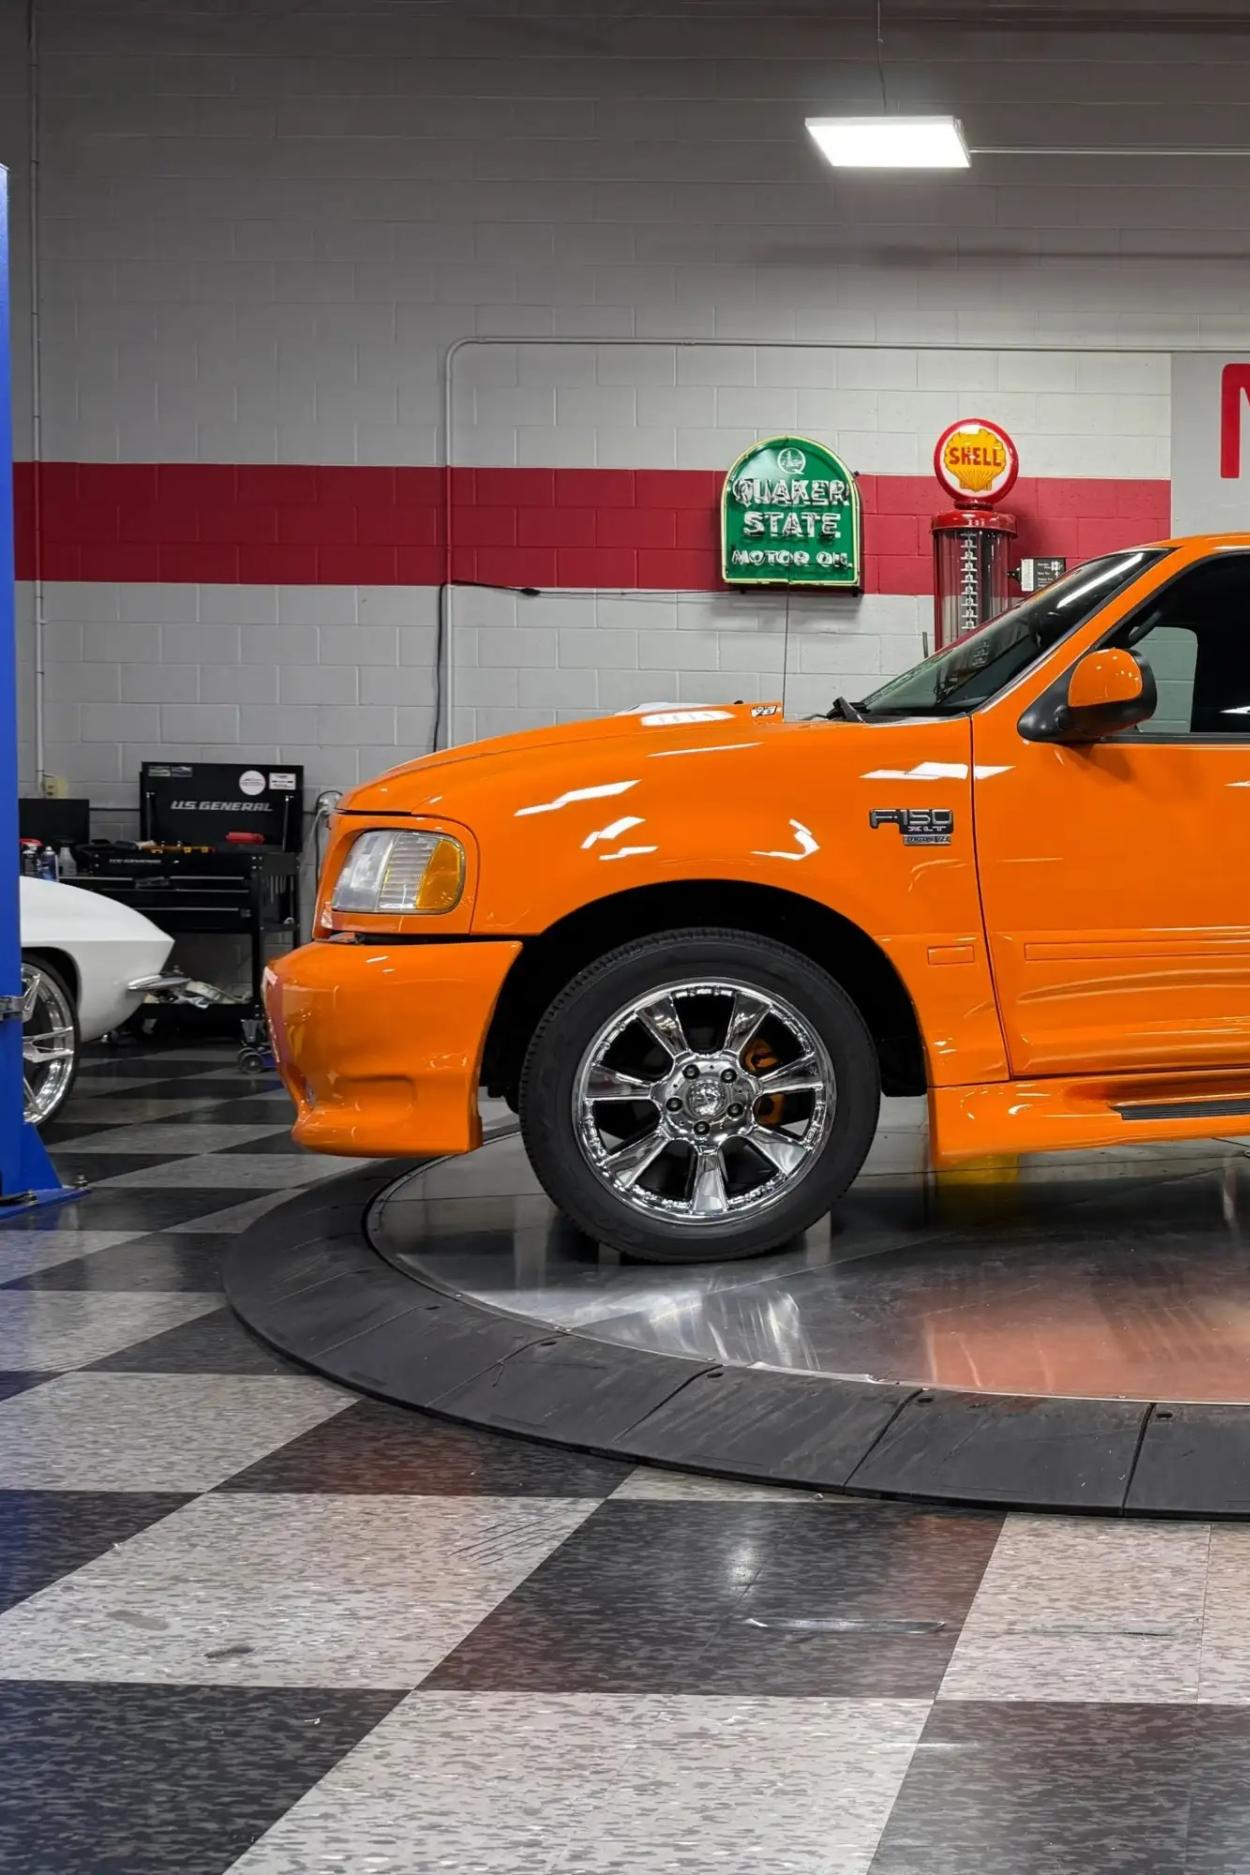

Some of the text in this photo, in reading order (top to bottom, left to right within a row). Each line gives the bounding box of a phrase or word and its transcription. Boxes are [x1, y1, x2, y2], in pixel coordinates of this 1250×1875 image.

[948, 446, 1002, 467] SHELL
[732, 479, 850, 507] QUAKER
[743, 511, 841, 538] STATE
[732, 549, 810, 567] MOTOR
[198, 801, 273, 812] GENERAL
[871, 809, 952, 827] F-150
